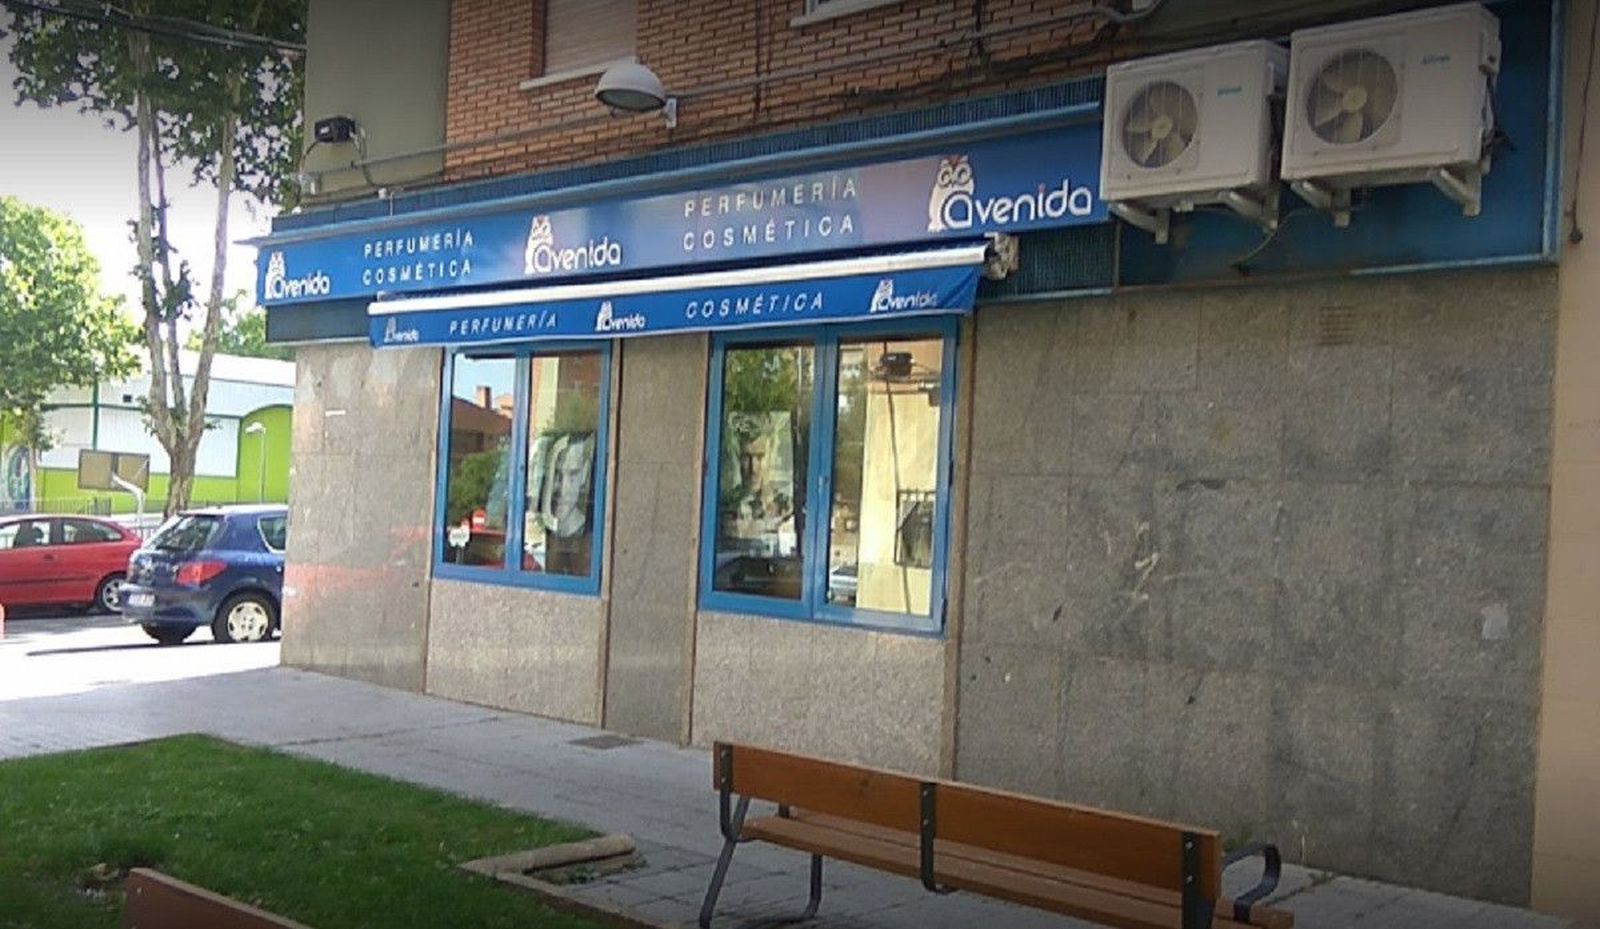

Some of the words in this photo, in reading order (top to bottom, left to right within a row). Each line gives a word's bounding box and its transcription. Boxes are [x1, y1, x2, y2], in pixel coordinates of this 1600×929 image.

[684, 174, 857, 218] PERFUMERÍA
[364, 228, 474, 259] PERFUMERÍA
[683, 213, 854, 251] COSMÉTICA
[362, 258, 471, 286] COSMÉTICA
[686, 291, 823, 319] COSMÉTICA
[450, 309, 558, 335] PERFUMERÍA
